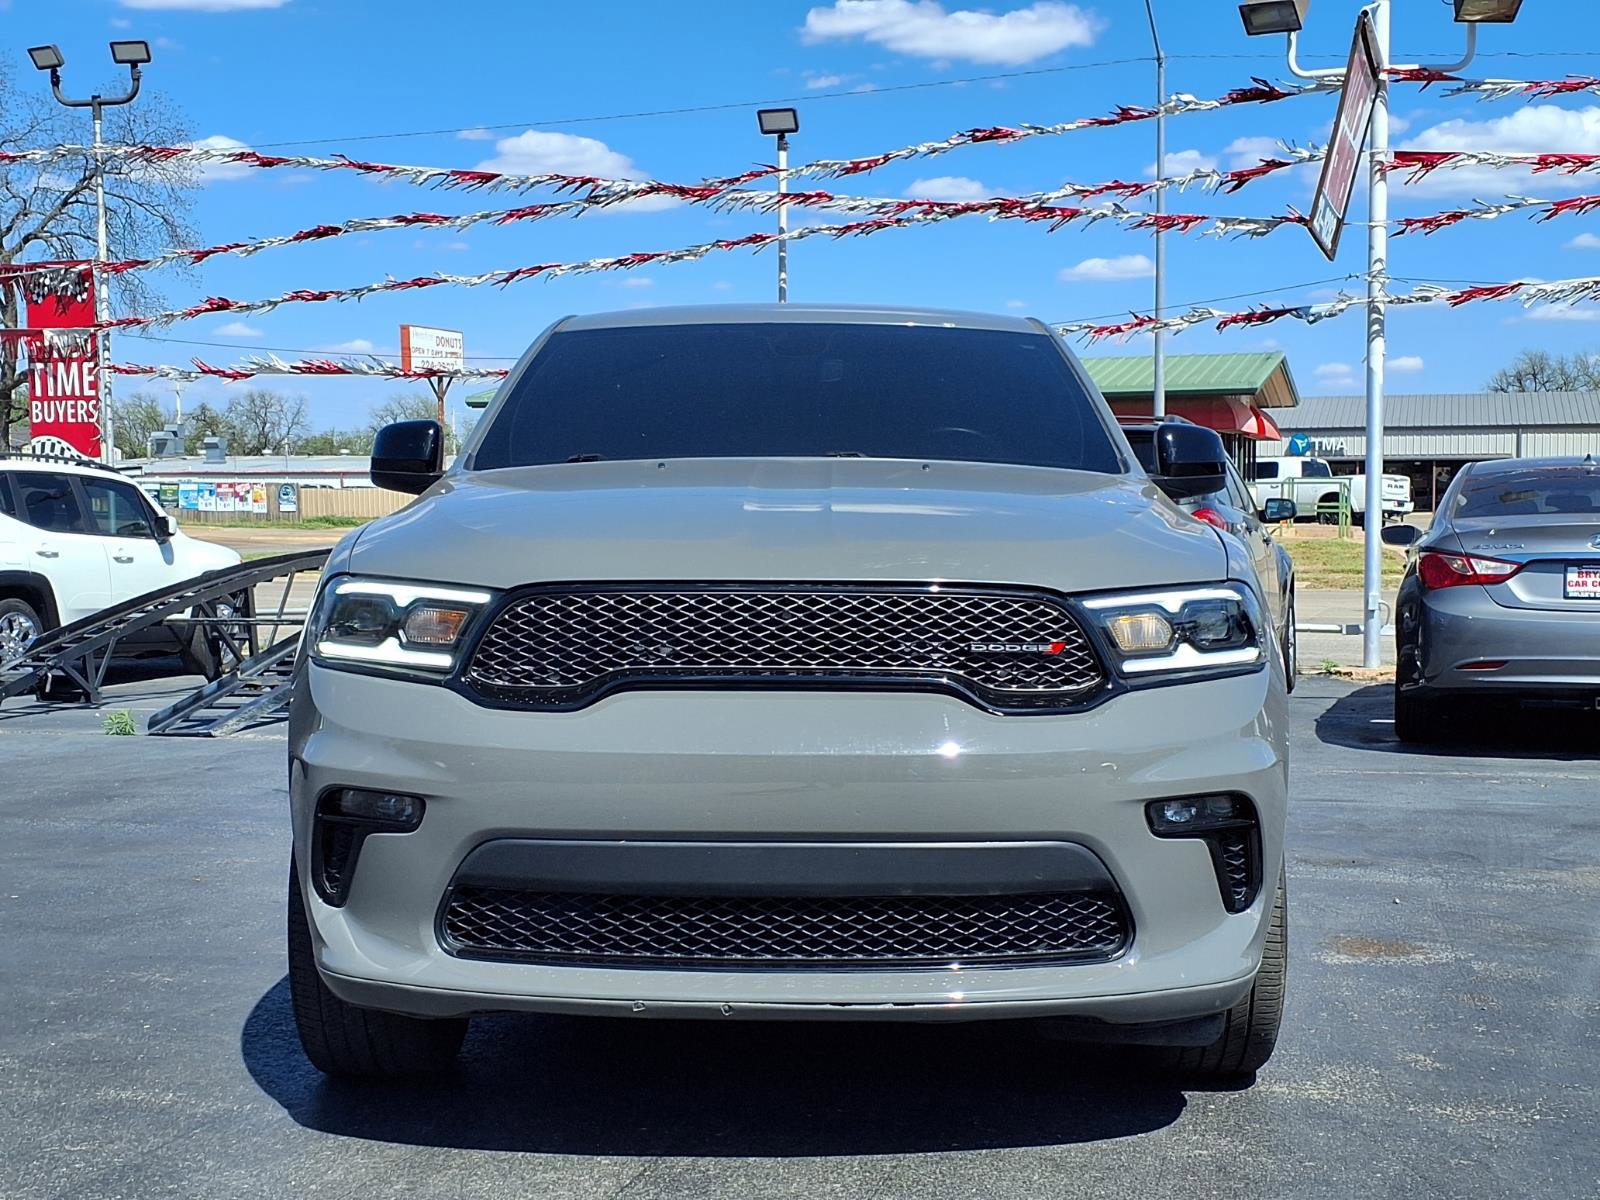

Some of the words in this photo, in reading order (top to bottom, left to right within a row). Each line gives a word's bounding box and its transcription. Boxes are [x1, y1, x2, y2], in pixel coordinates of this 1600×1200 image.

[435, 335, 462, 350] DONUTS
[412, 346, 425, 354] OPEN
[30, 361, 96, 397] TIME
[31, 400, 97, 423] BUYERS
[1311, 438, 1347, 452] TMA
[1567, 580, 1588, 588] CAR
[1591, 580, 1600, 588] C
[970, 643, 1052, 652] DODGE
